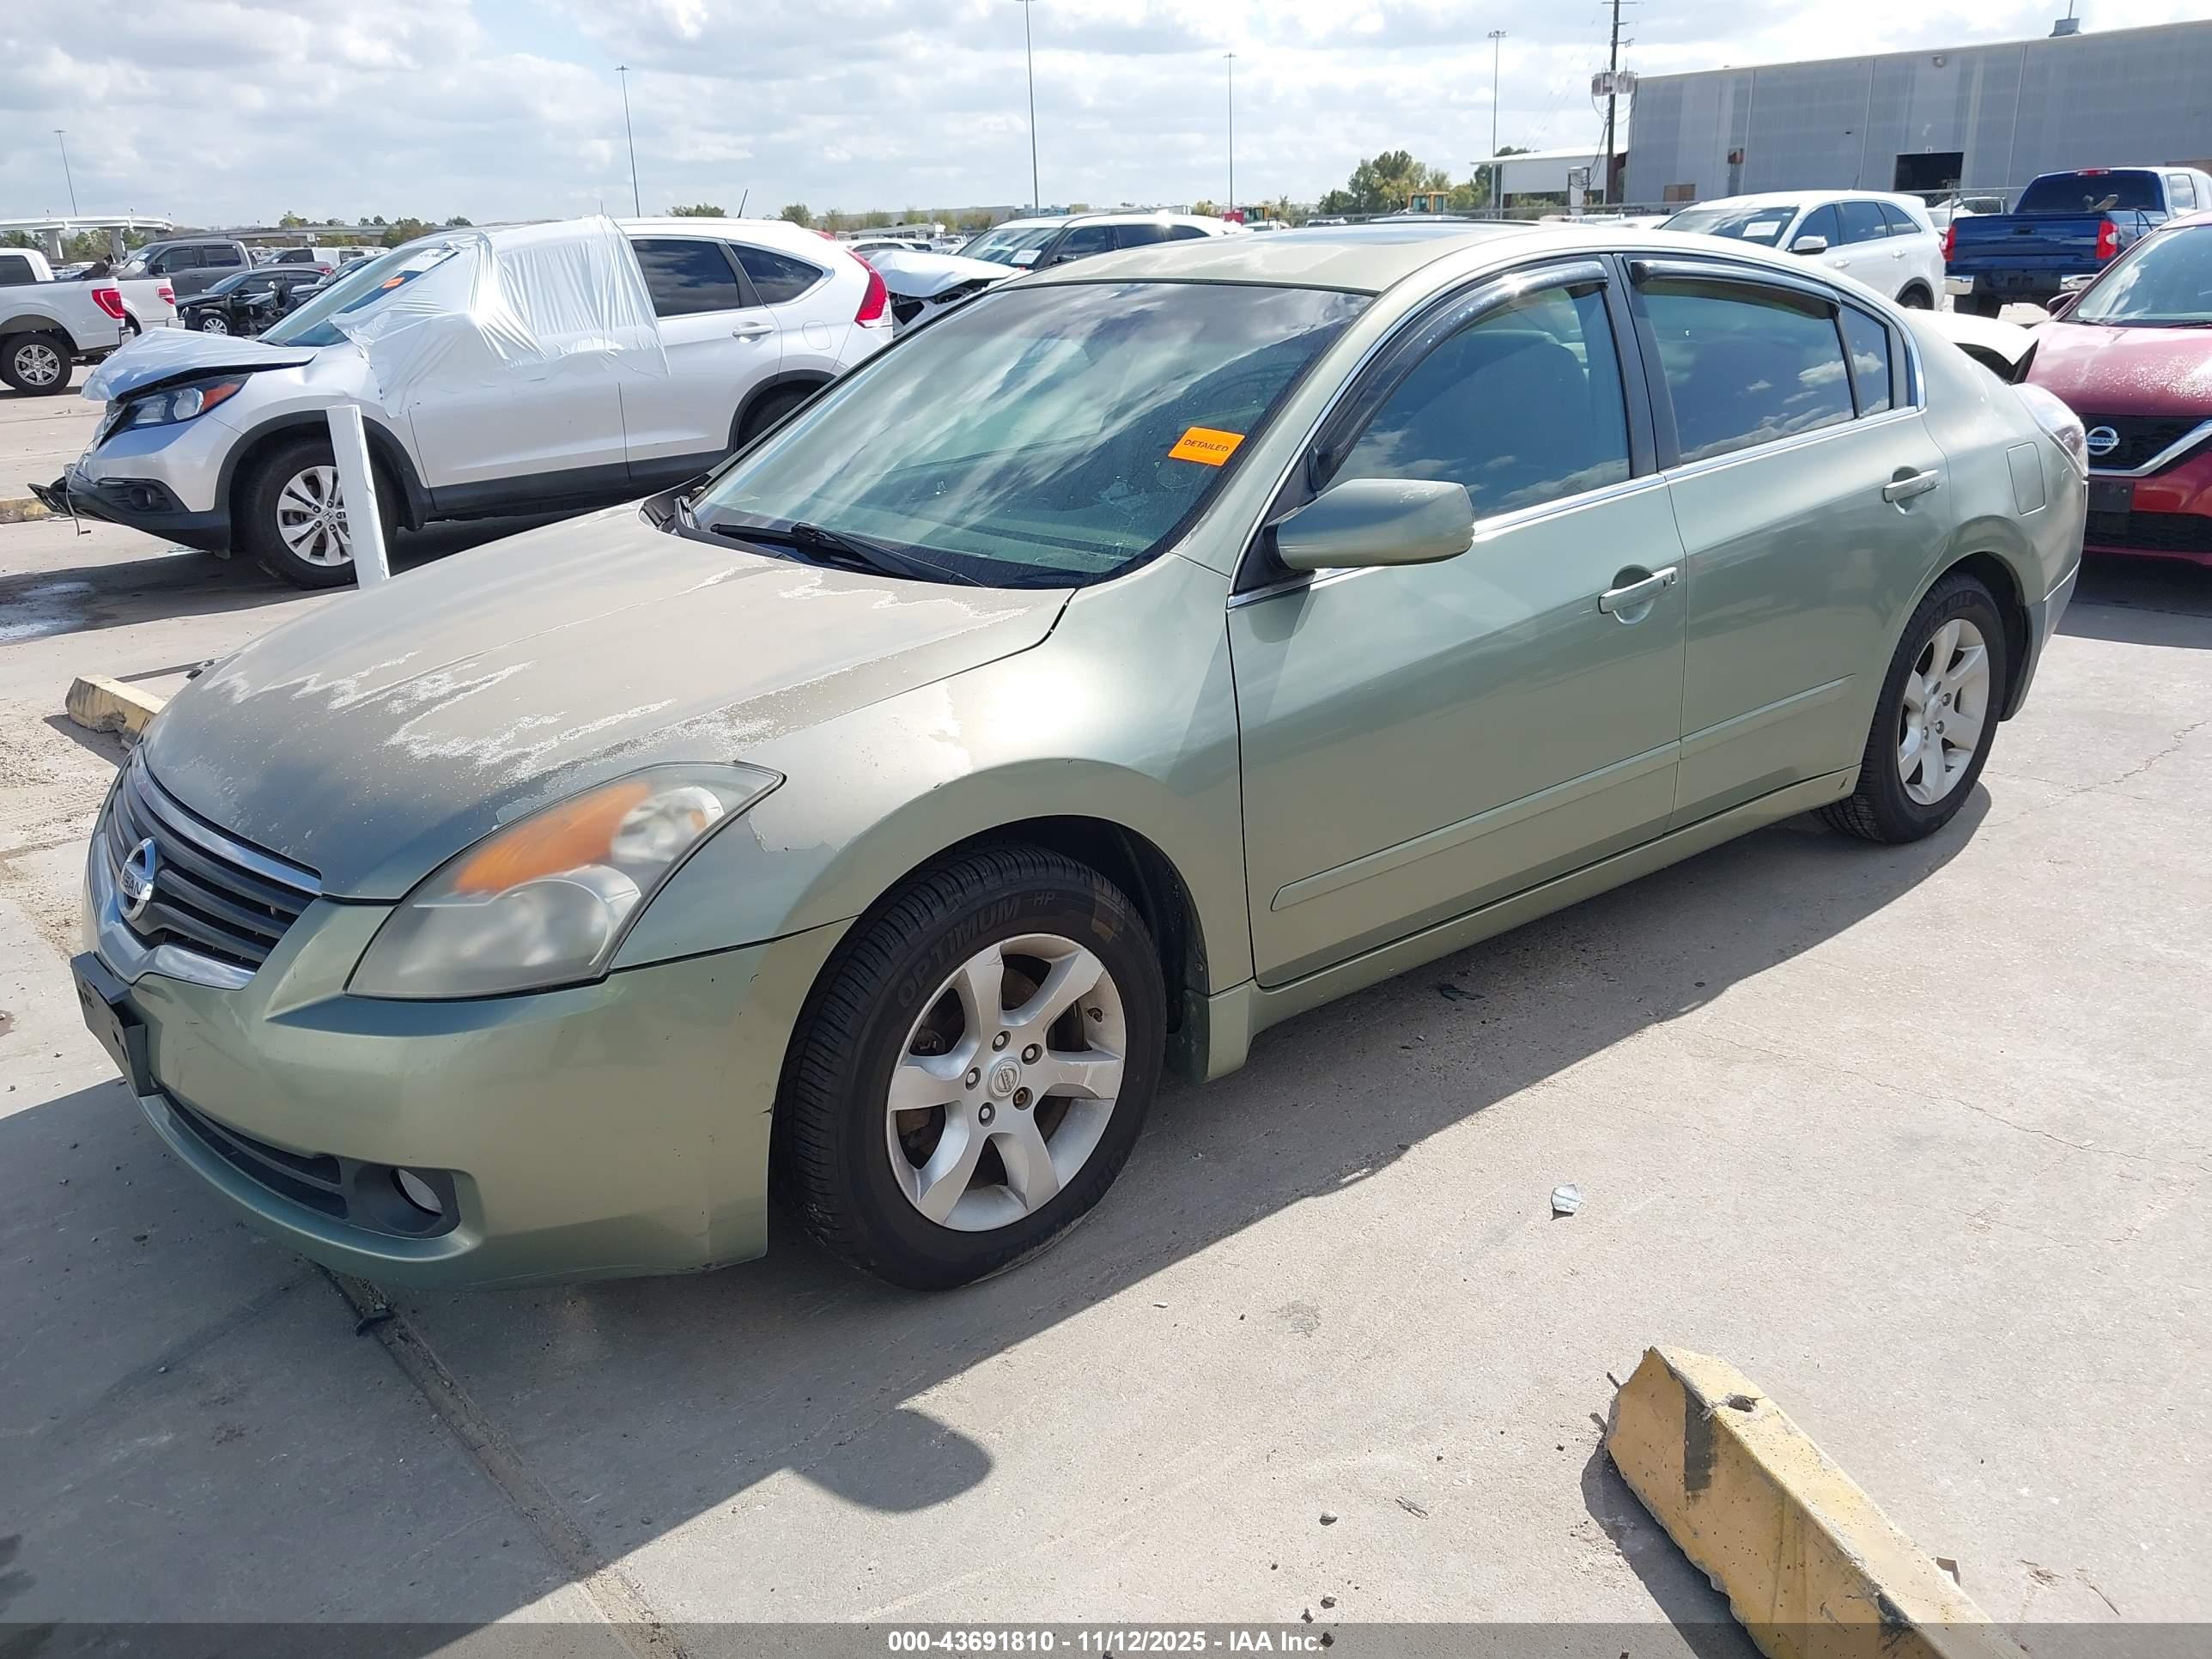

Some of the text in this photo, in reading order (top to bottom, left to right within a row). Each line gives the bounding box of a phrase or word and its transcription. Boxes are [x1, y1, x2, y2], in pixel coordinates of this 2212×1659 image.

[1183, 439, 1229, 453] DETAILED
[897, 890, 1056, 1007] OPTIMUM HP
